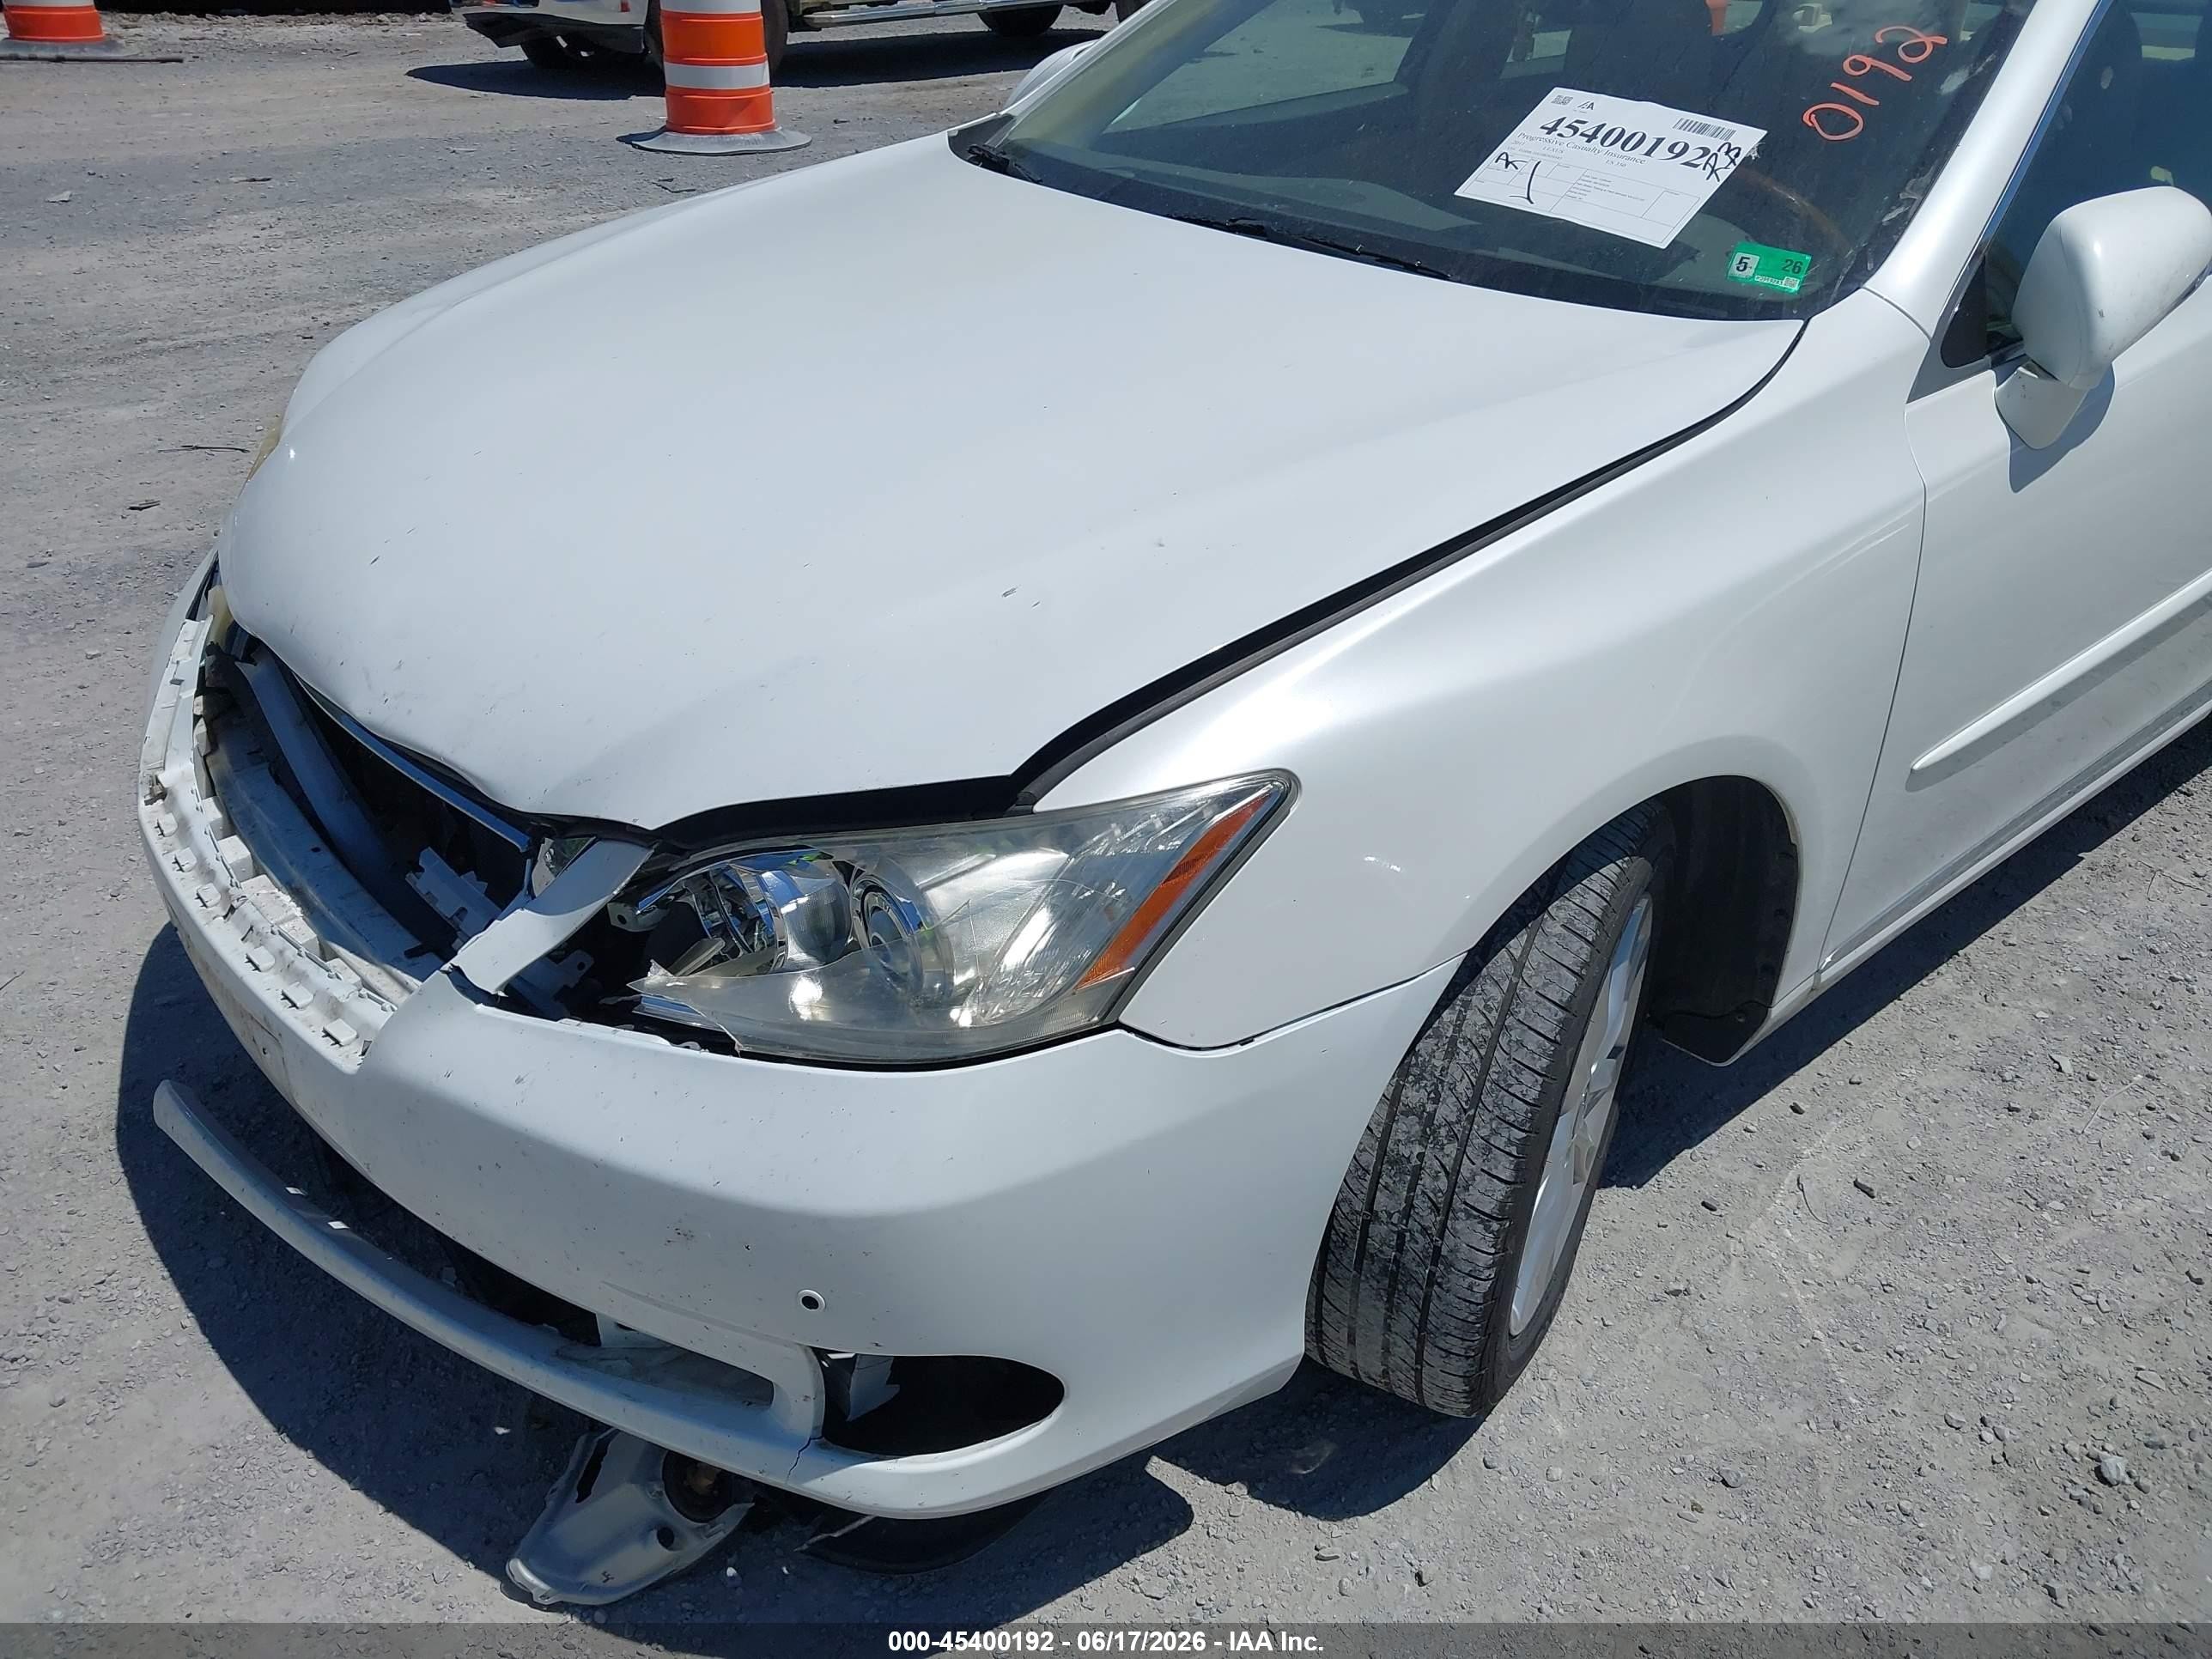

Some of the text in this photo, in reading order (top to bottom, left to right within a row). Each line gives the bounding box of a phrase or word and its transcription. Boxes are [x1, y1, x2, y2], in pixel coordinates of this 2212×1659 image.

[1802, 25, 1948, 141] 0192
[1518, 132, 1565, 147] Progressive
[1566, 141, 1603, 155] Casualty
[1604, 149, 1646, 165] Insurance
[1540, 116, 1711, 168] 45400192
[1735, 256, 1803, 275] 5 26
